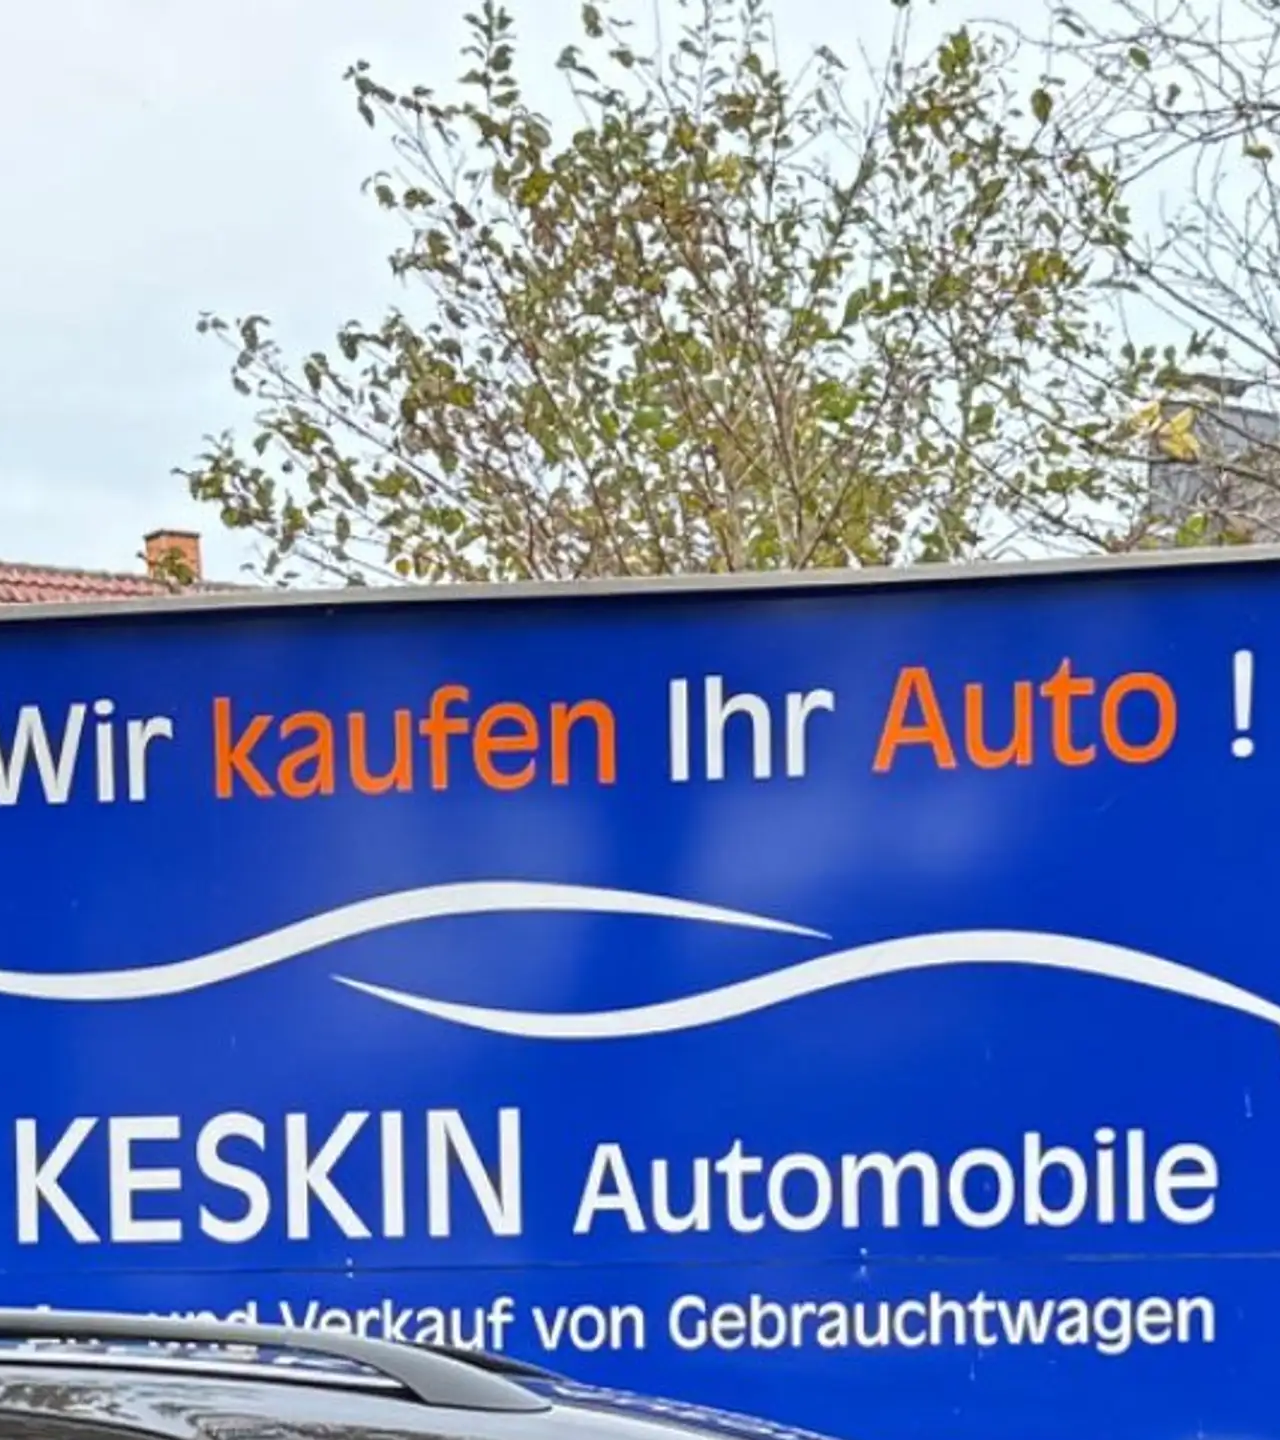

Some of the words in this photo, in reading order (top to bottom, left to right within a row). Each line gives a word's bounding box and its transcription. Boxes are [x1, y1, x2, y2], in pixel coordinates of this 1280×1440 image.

[213, 684, 616, 799] kaufen
[670, 675, 835, 782] Ihr
[871, 657, 1178, 773] Auto
[1231, 650, 1255, 758] !
[14, 1107, 523, 1244] KESKIN
[572, 1127, 1219, 1234] Automobile
[532, 1305, 646, 1351] von
[669, 1291, 1216, 1355] Gebrauchtwagen
